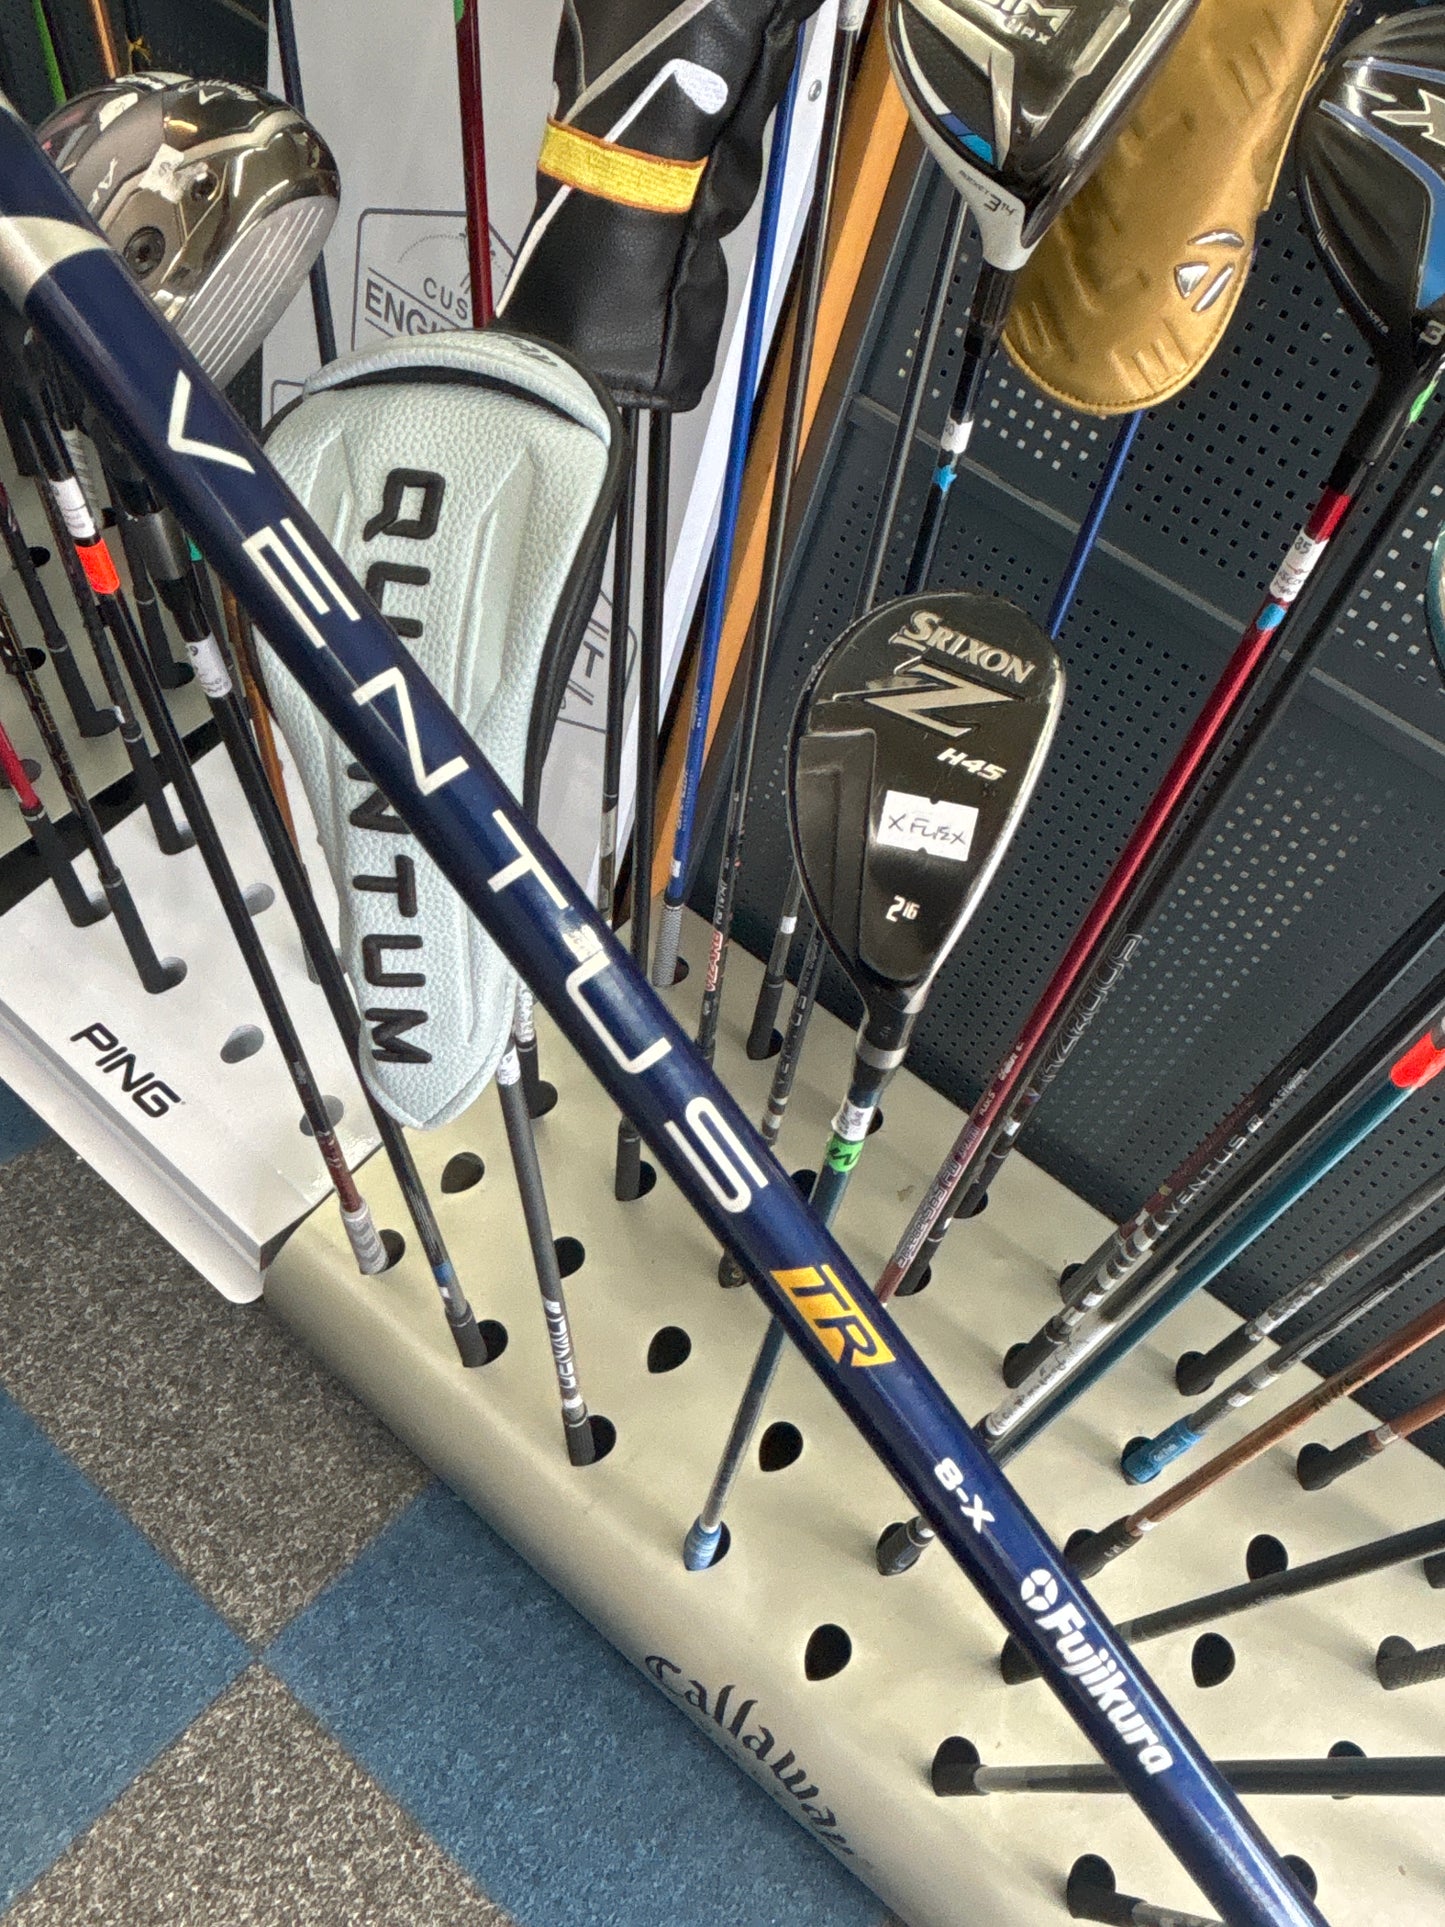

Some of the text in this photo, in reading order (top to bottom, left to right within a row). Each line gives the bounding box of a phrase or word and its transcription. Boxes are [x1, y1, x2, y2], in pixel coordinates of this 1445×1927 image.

[423, 277, 469, 321] CUS
[888, 610, 1036, 685] SRIXON
[166, 369, 770, 1216] VENTUS
[347, 466, 446, 1065] QUNTUM
[937, 748, 1006, 781] H45
[705, 930, 724, 992] VIZARD
[70, 1022, 182, 1118] PING
[1164, 1133, 1248, 1215] VENTUS
[547, 1314, 577, 1390] DENALI
[932, 1456, 996, 1533] 8-X
[1036, 1601, 1174, 1775] Fujikura
[643, 1653, 858, 1858] Callaway
